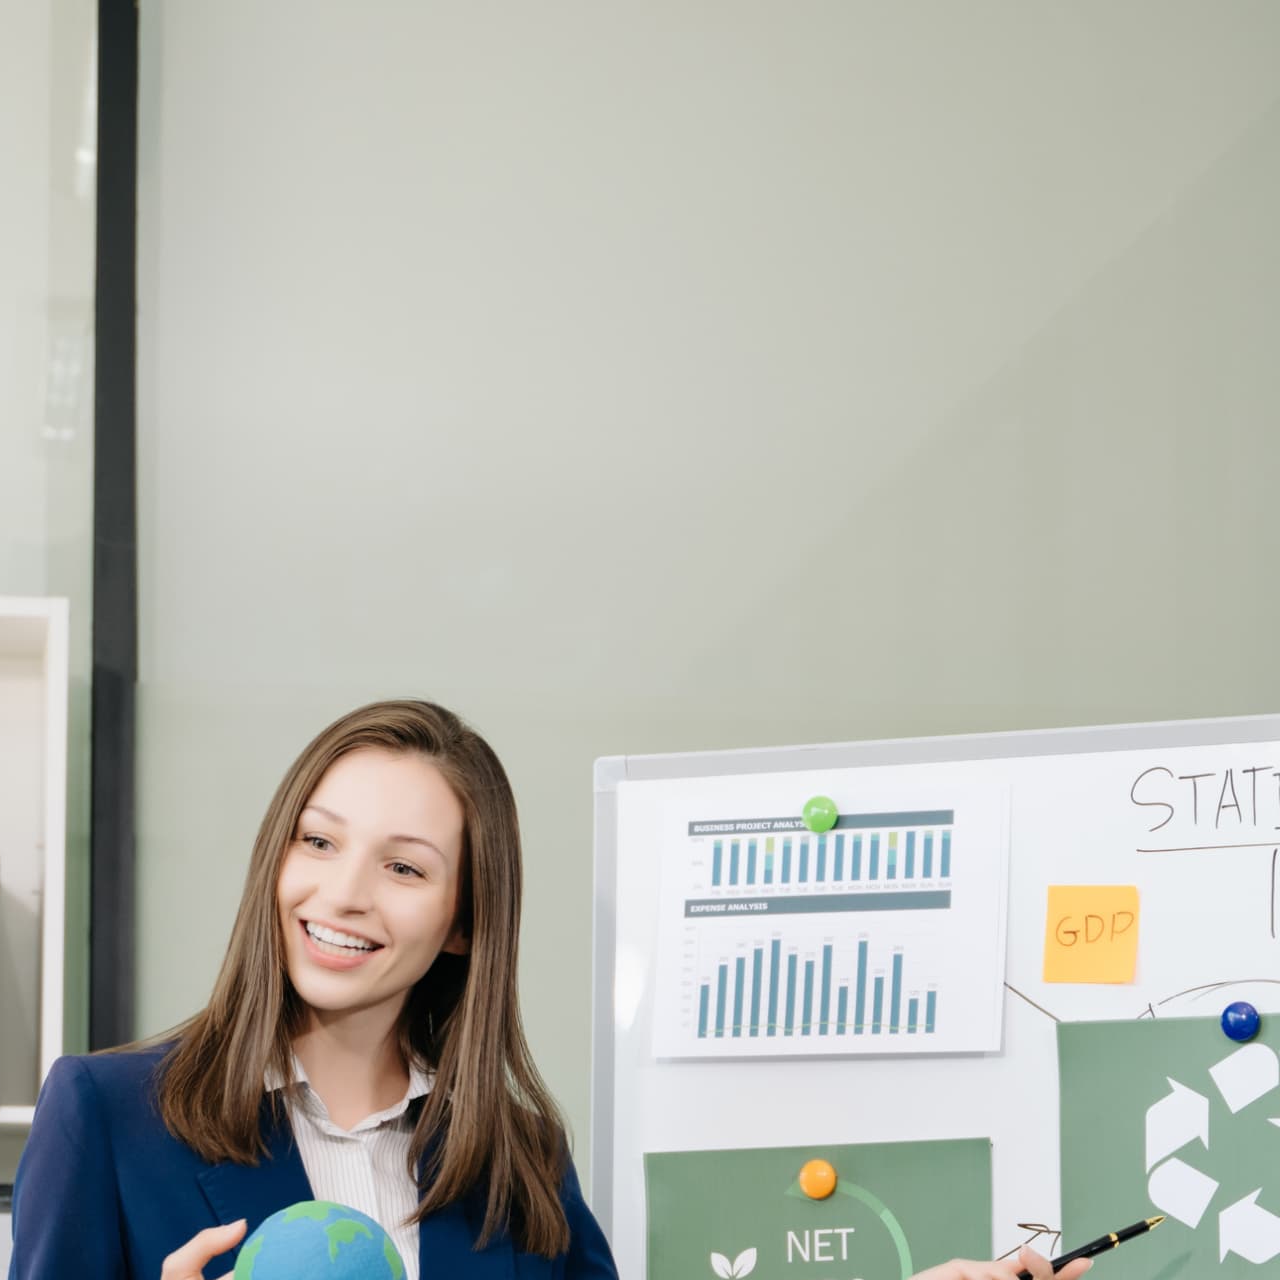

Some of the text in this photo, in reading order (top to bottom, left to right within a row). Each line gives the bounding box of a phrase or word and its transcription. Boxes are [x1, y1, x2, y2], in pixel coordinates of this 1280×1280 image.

[693, 820, 806, 833] BUSINESS PROJECT ANALYS
[690, 902, 768, 913] EXPENSE ANALYSIS
[1055, 911, 1135, 947] GDP
[787, 1227, 855, 1263] NET
